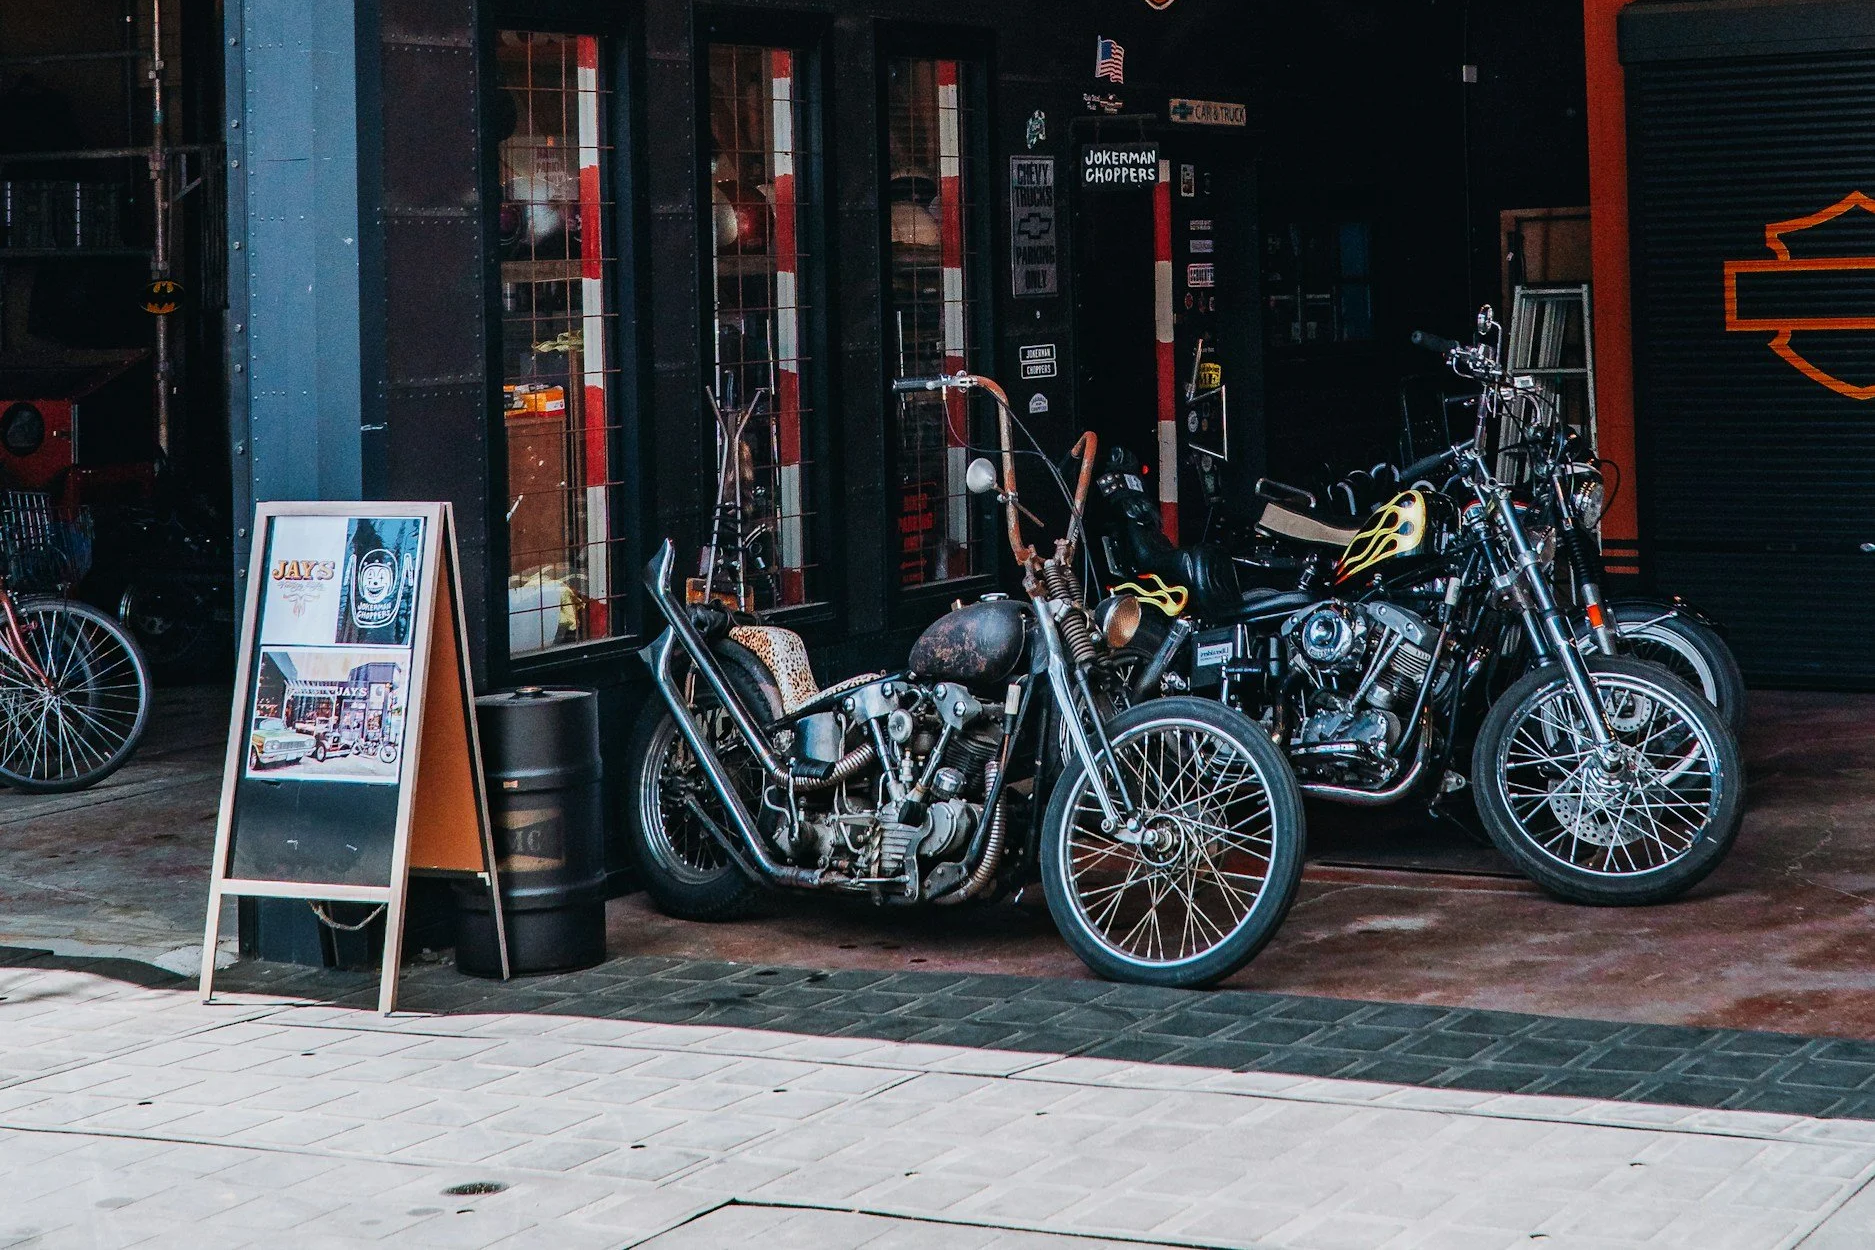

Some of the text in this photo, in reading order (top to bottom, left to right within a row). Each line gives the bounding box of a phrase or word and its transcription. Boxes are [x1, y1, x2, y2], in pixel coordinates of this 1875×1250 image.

[1085, 150, 1156, 166] JOKERMAN
[1017, 163, 1049, 185] CHEVY
[1085, 167, 1156, 183] CHOPPERS
[1015, 186, 1053, 207] TRUCKS
[1016, 245, 1055, 265] PARKING
[1025, 269, 1047, 289] ONLY
[1026, 348, 1052, 359] JOKERMAN
[1026, 364, 1052, 376] CHOPPERS
[357, 602, 392, 611] JOKERMAN
[356, 610, 391, 620] CHOPPERS
